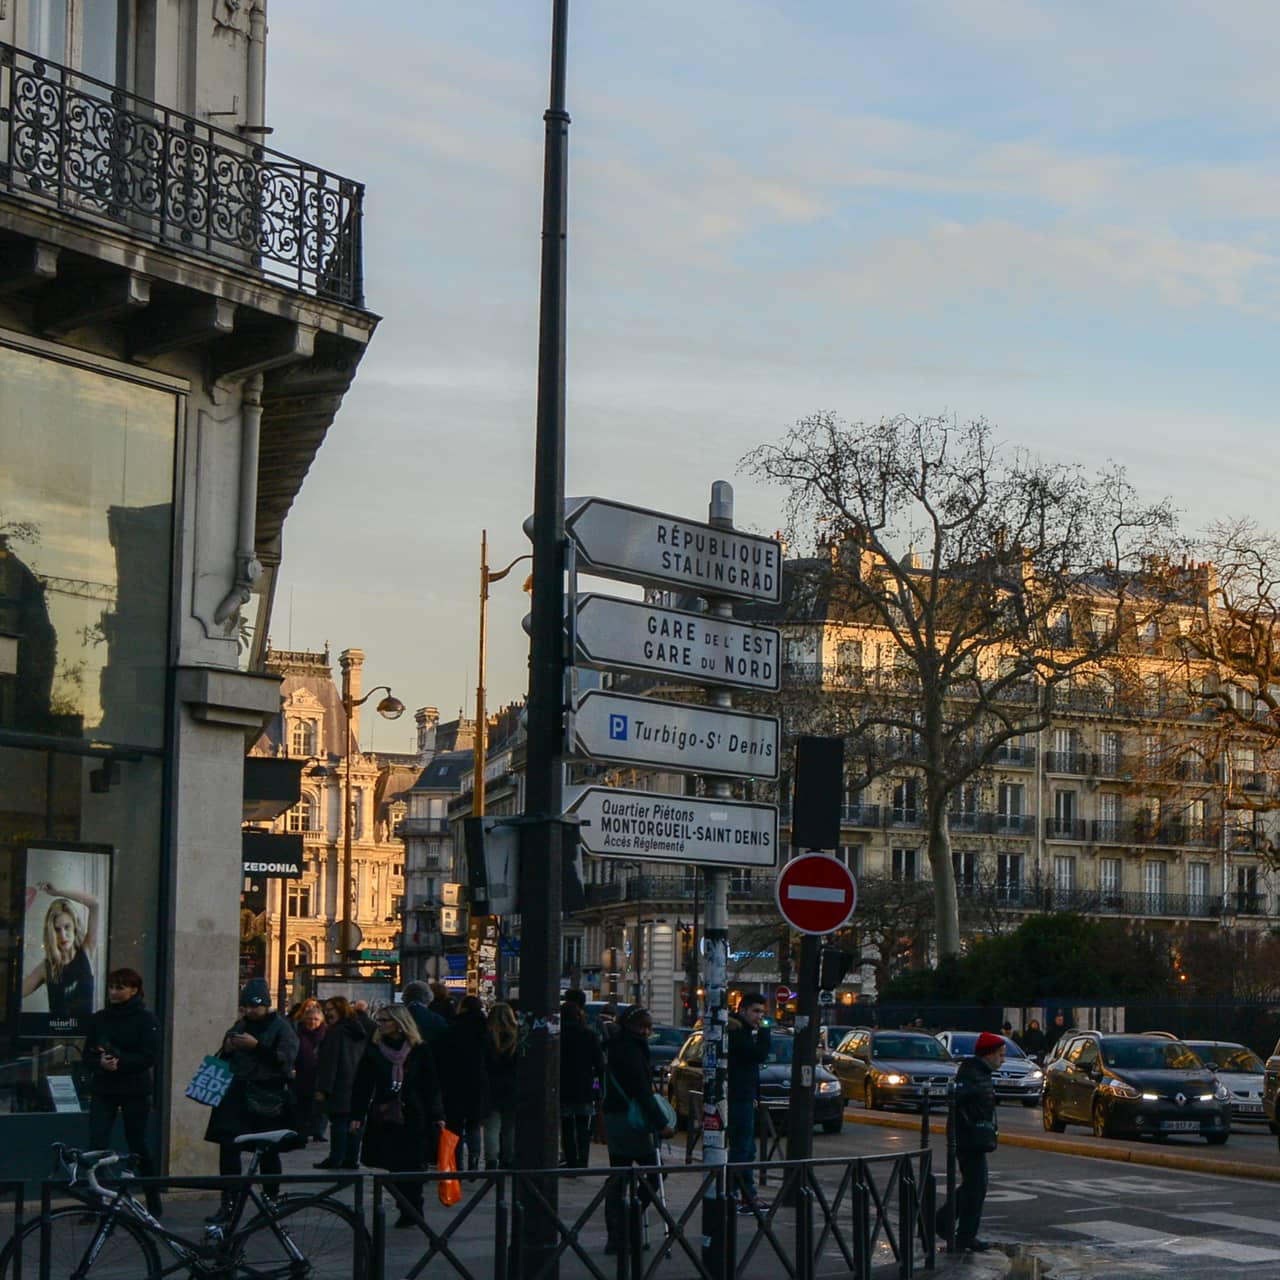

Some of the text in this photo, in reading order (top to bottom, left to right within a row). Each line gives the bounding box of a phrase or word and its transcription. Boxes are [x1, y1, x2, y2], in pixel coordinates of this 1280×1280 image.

[657, 524, 773, 568] RÉPUBLIQUE
[662, 551, 773, 591] STALINGRAD
[648, 616, 695, 641] GARE
[705, 633, 719, 646] DE
[743, 634, 772, 655] EST
[644, 641, 771, 679] GARE DU NORD
[728, 734, 772, 757] Denis
[602, 799, 695, 822] Quartier Piétons
[601, 817, 770, 846] MONTORGUEIL-SAINT DENIS
